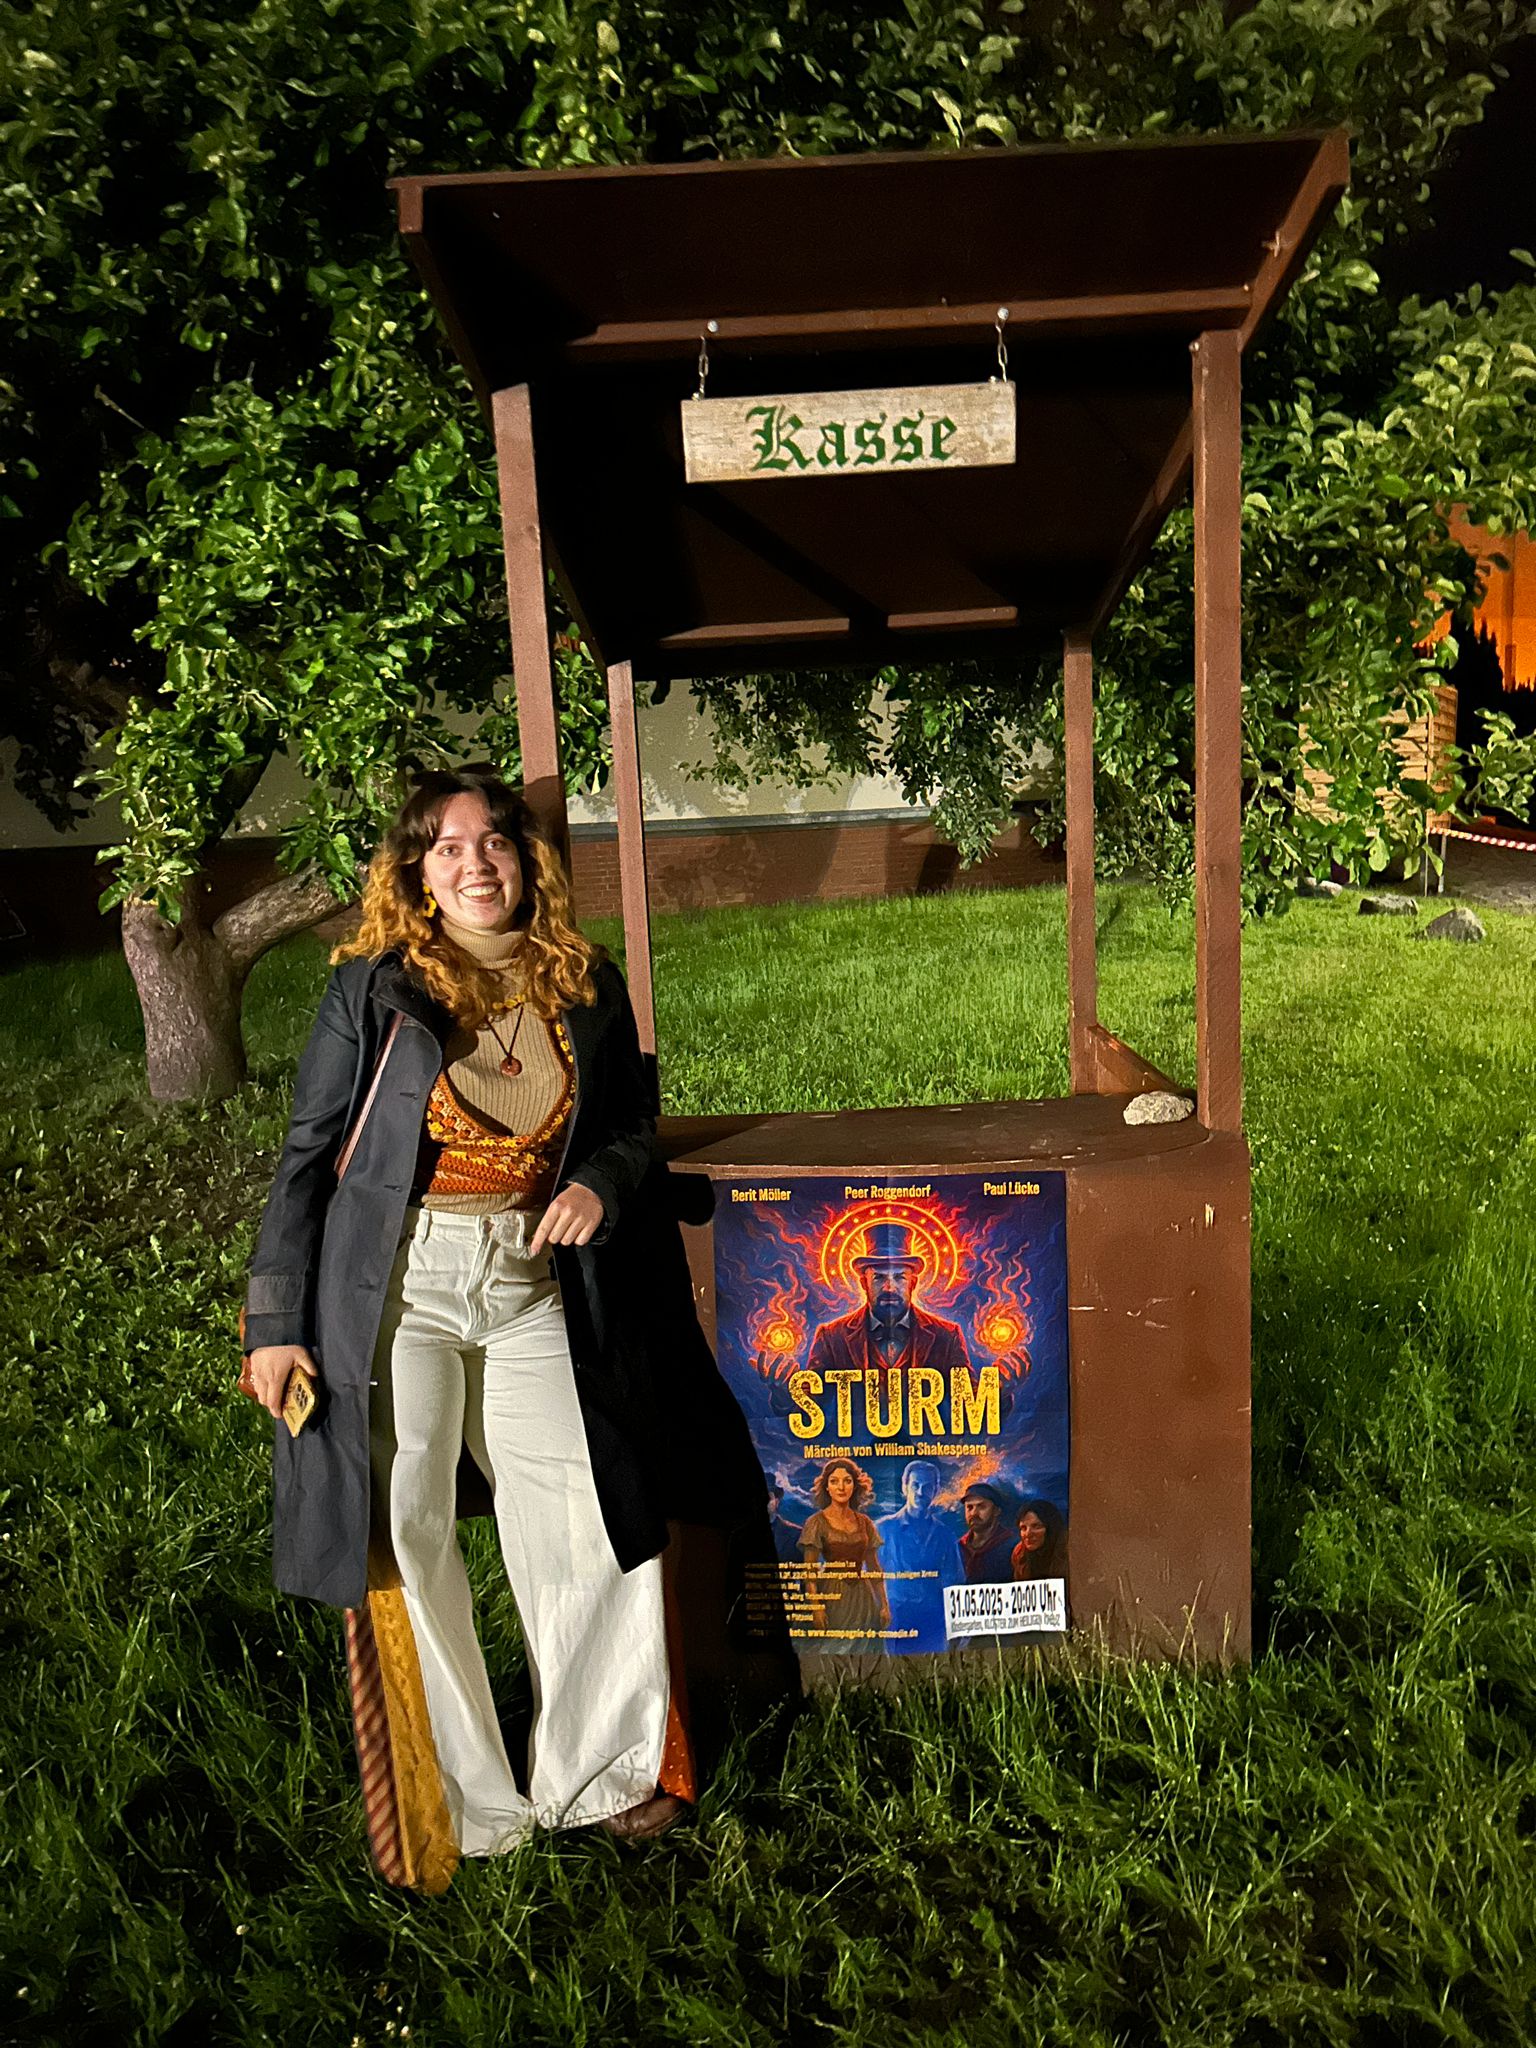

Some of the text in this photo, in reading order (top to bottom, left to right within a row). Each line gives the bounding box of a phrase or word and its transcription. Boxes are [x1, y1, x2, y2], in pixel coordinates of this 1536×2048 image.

[745, 404, 957, 473] Kasse
[731, 1187, 792, 1202] Berit Möller
[844, 1184, 931, 1200] Peer Roggendorf
[983, 1181, 1040, 1195] Paul Lücke
[788, 1366, 1001, 1440] STURM
[803, 1444, 851, 1458] Märchen
[853, 1446, 873, 1457] von
[875, 1443, 915, 1457] William
[950, 1588, 1003, 1619] 31.05.2025
[1011, 1585, 1037, 1614] 20:00
[1039, 1582, 1057, 1613] Uhr
